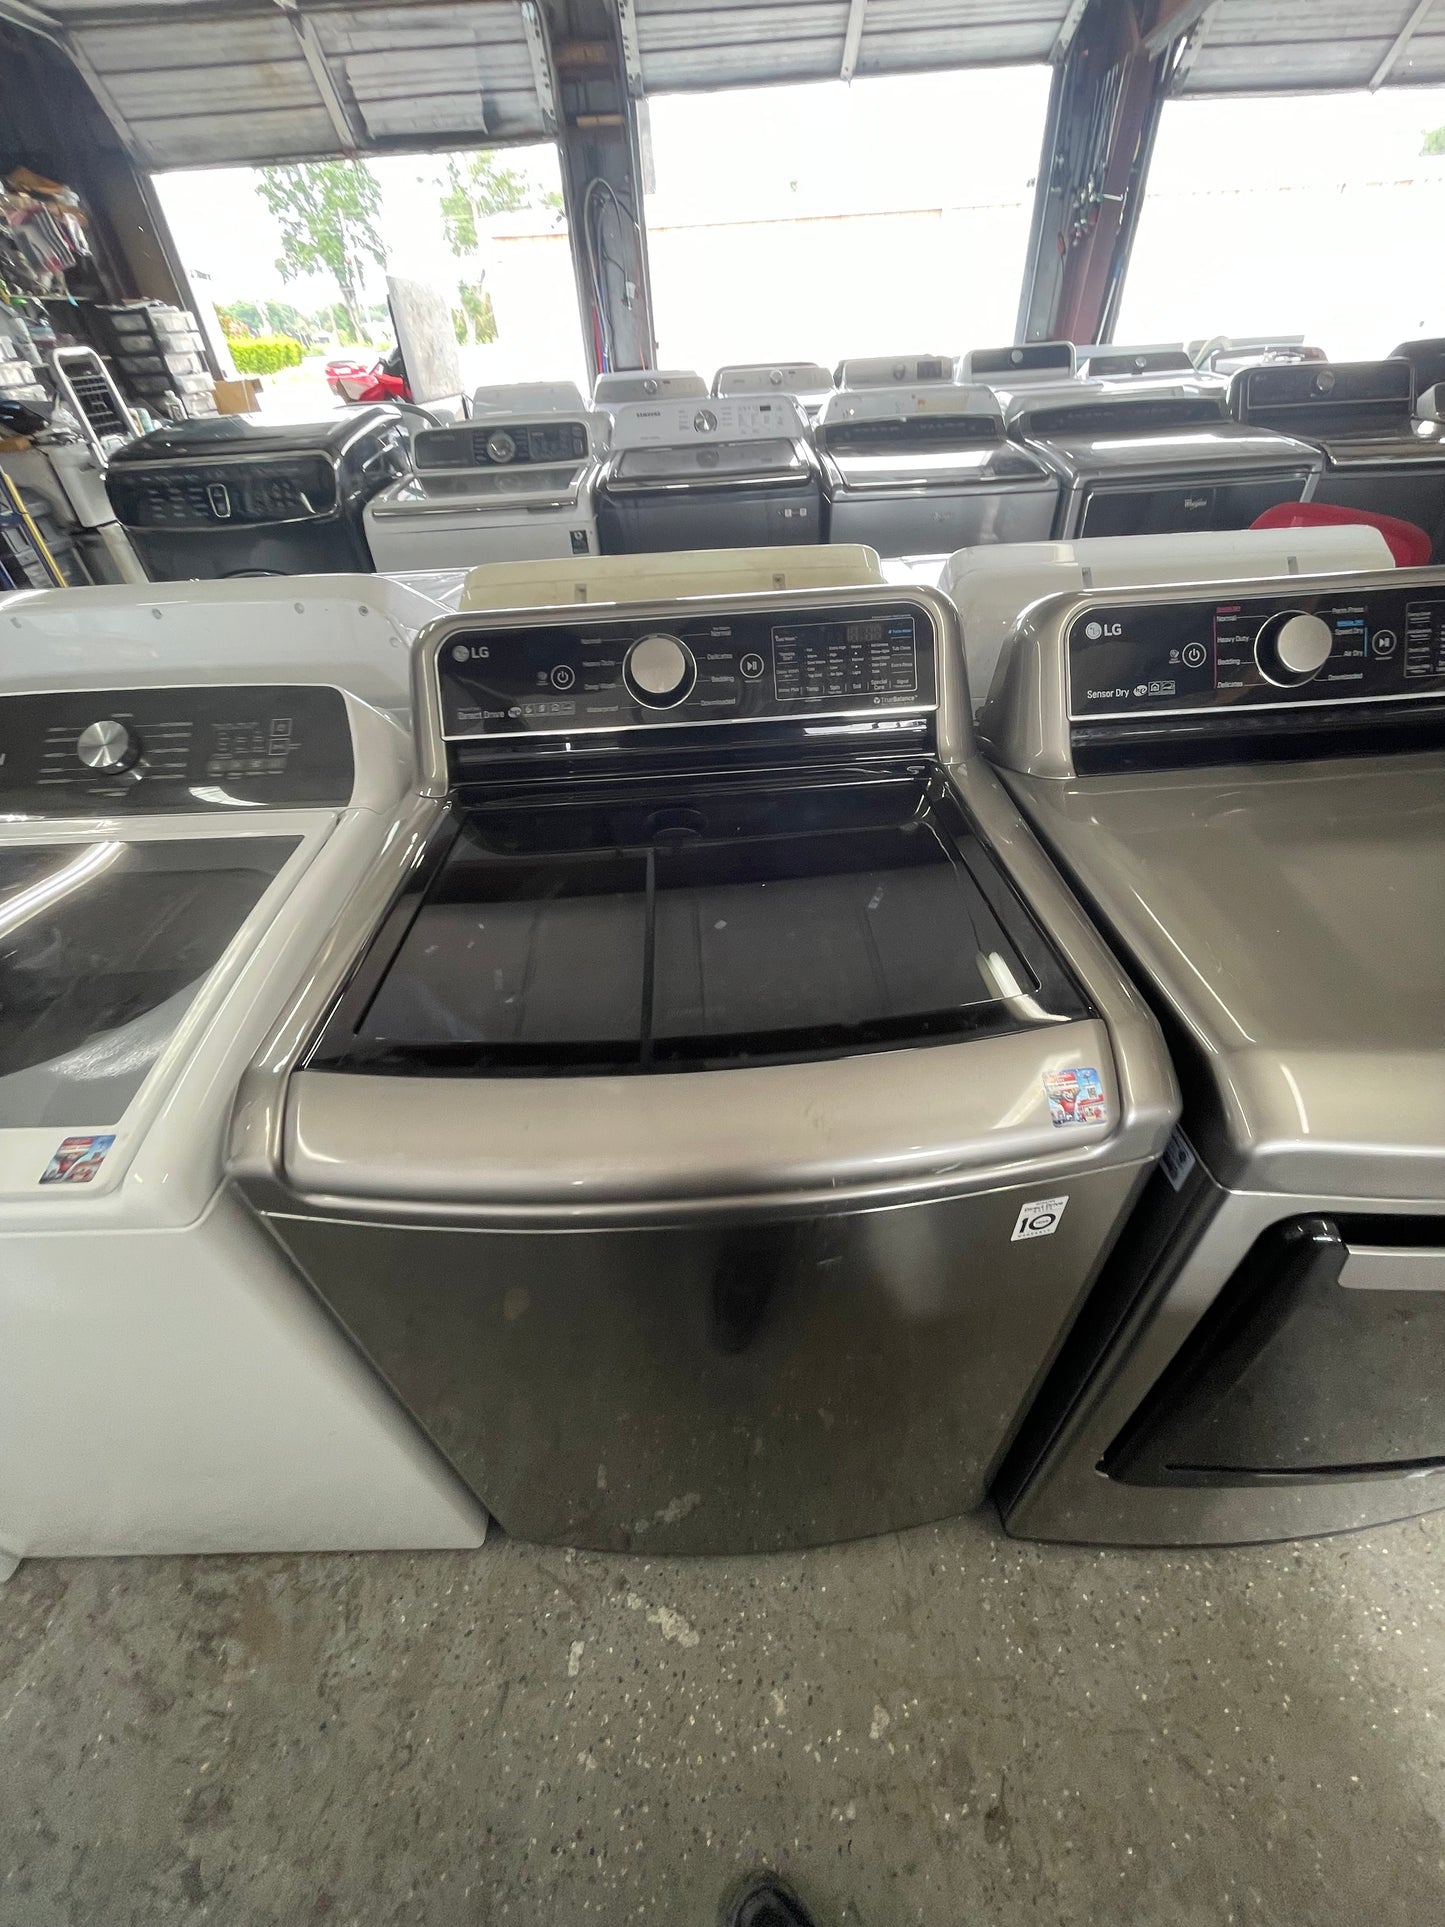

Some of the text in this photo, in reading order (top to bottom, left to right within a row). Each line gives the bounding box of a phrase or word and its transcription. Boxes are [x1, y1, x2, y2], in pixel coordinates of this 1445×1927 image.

[1103, 623, 1122, 637] LG
[471, 646, 490, 659] LG
[1087, 690, 1114, 699] Sensor
[1115, 688, 1130, 698] Dry
[483, 710, 505, 719] Drive
[1019, 1213, 1056, 1234] 10
